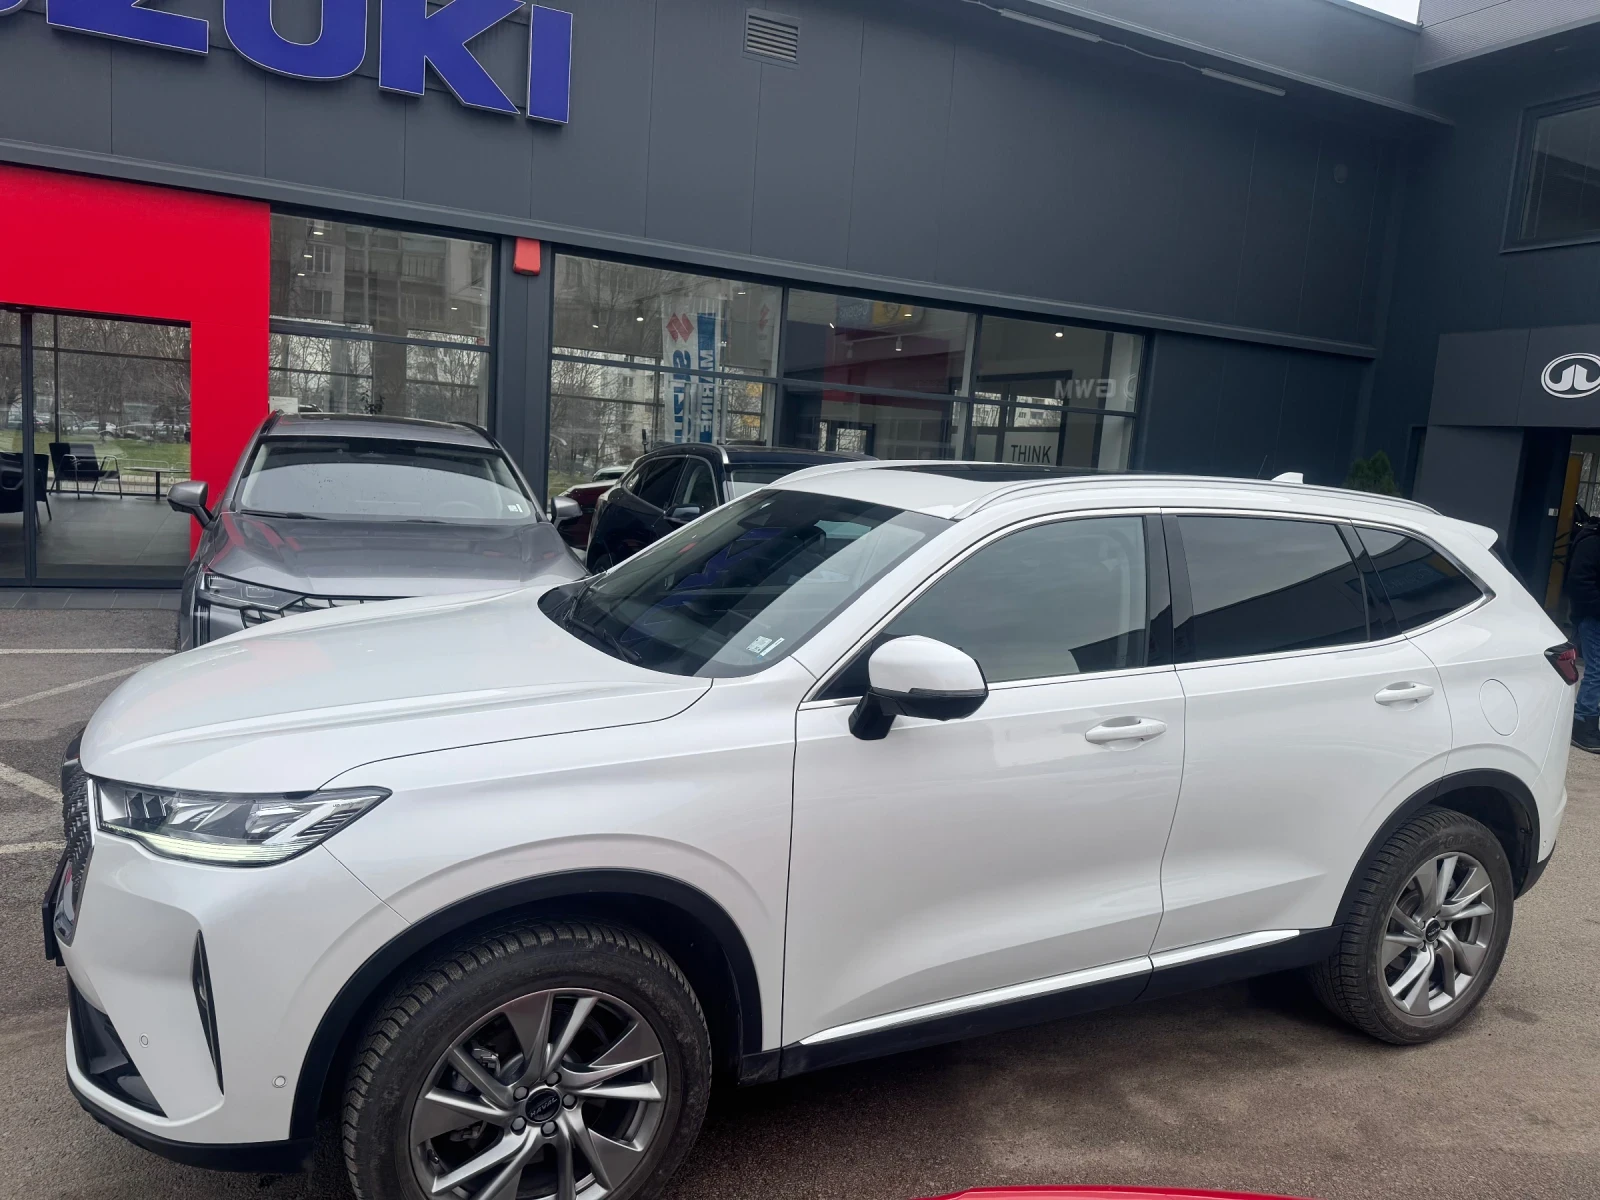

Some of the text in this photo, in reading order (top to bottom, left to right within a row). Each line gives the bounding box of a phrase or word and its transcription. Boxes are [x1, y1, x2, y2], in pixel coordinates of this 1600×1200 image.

[0, 0, 573, 124] UKI
[1010, 444, 1052, 464] THINK
[530, 1097, 558, 1118] HAVAL
